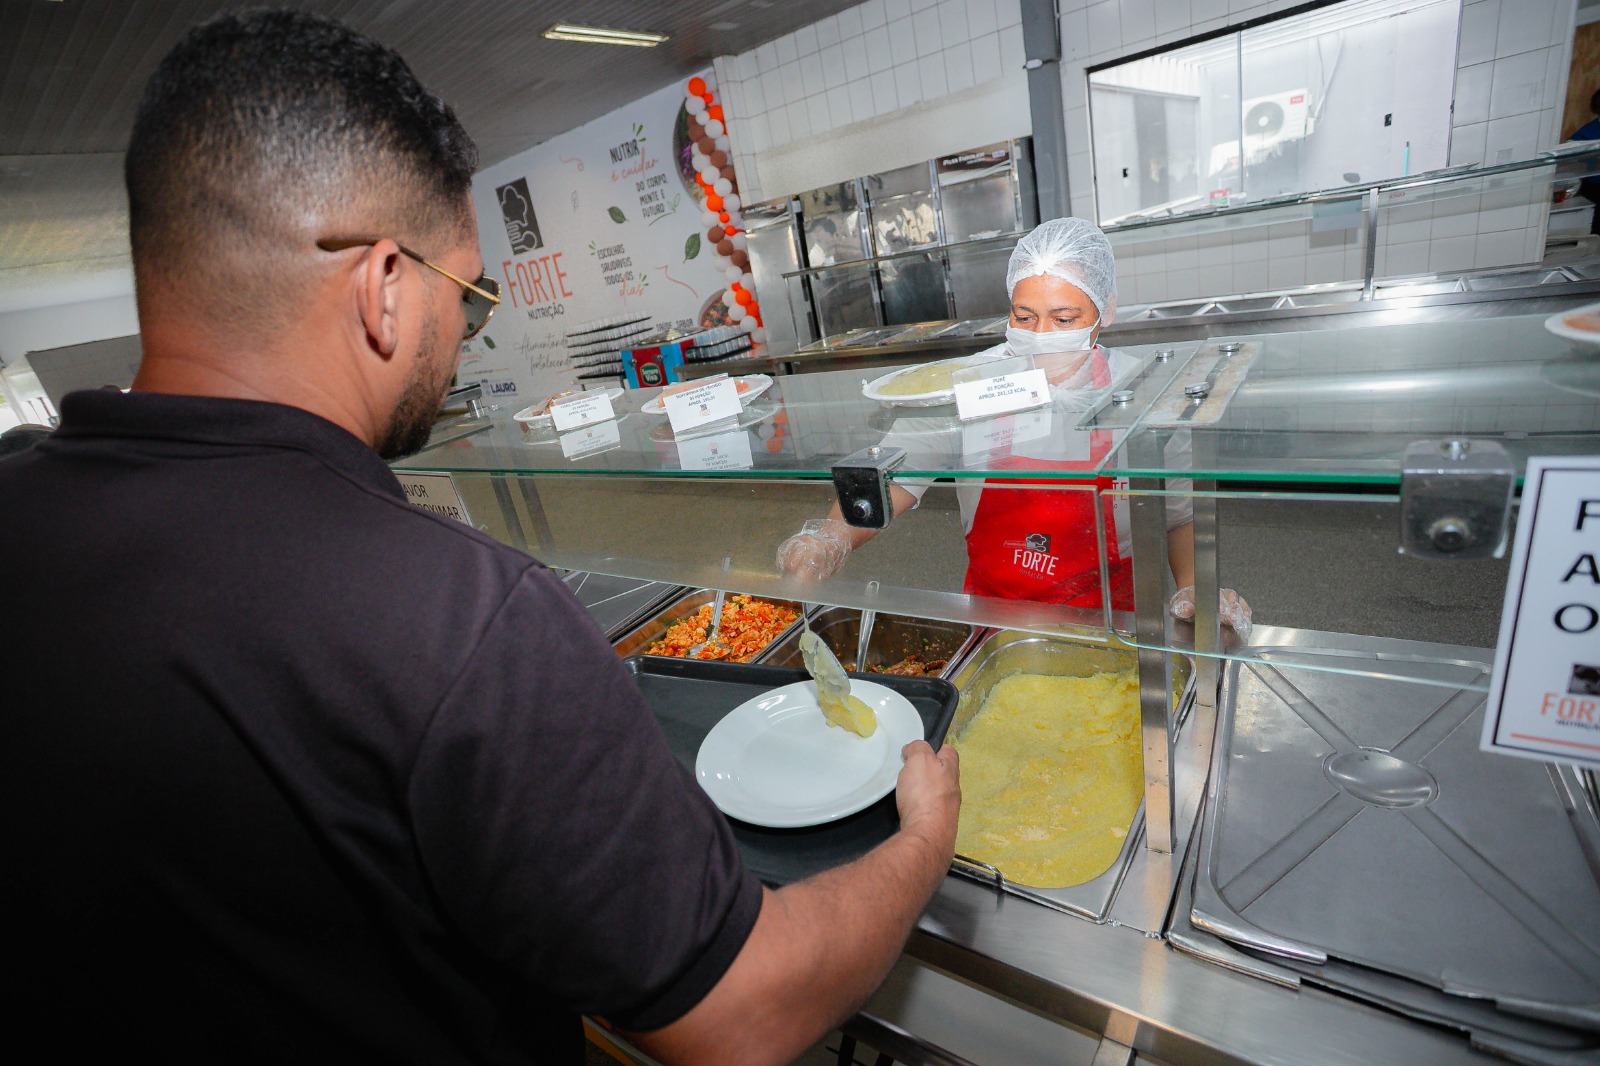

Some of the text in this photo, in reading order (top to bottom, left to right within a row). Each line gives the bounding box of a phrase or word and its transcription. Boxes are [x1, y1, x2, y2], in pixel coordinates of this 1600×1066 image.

[609, 138, 640, 164] NUTRIR
[621, 144, 660, 178] cuidar
[636, 180, 645, 192] DO
[639, 188, 666, 205] MENTE E
[642, 203, 665, 219] FUTURO
[596, 243, 625, 260] ESCOLHAS
[502, 250, 573, 309] FORTE
[604, 272, 625, 286] TODOS
[527, 302, 565, 320] NUTRIÇÃO
[490, 381, 516, 394] LAURO
[994, 382, 1015, 390] PORÇÃO
[1014, 386, 1027, 394] KCAL
[402, 483, 429, 498] AVOR
[1574, 498, 1600, 532] F
[1013, 549, 1060, 576] FORTE
[1560, 552, 1600, 584] A
[1540, 691, 1600, 725] FOR
